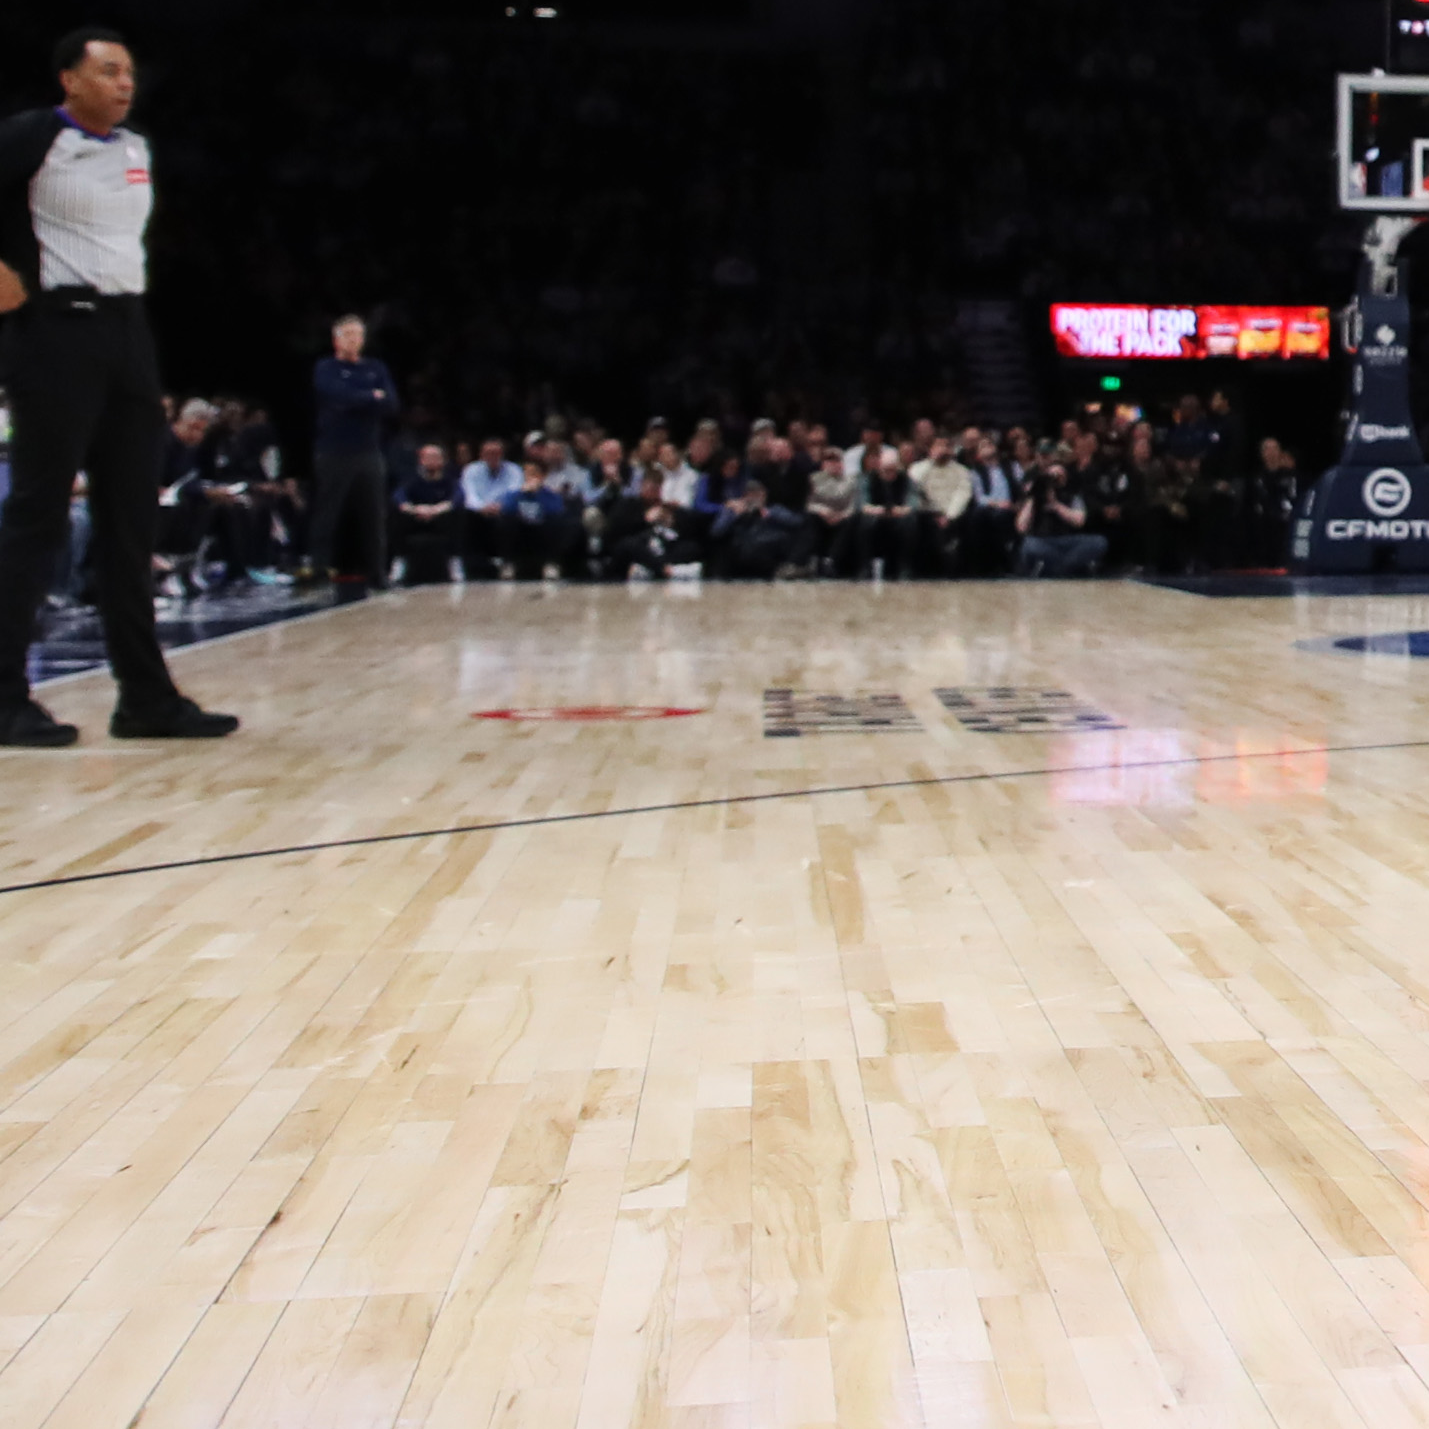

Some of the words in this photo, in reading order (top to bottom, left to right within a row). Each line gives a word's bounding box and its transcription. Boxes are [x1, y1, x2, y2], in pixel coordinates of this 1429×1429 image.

[1056, 306, 1148, 333] PROTEIN
[1151, 308, 1197, 336] FOR
[1079, 331, 1120, 355] THE
[1121, 332, 1183, 356] PACK
